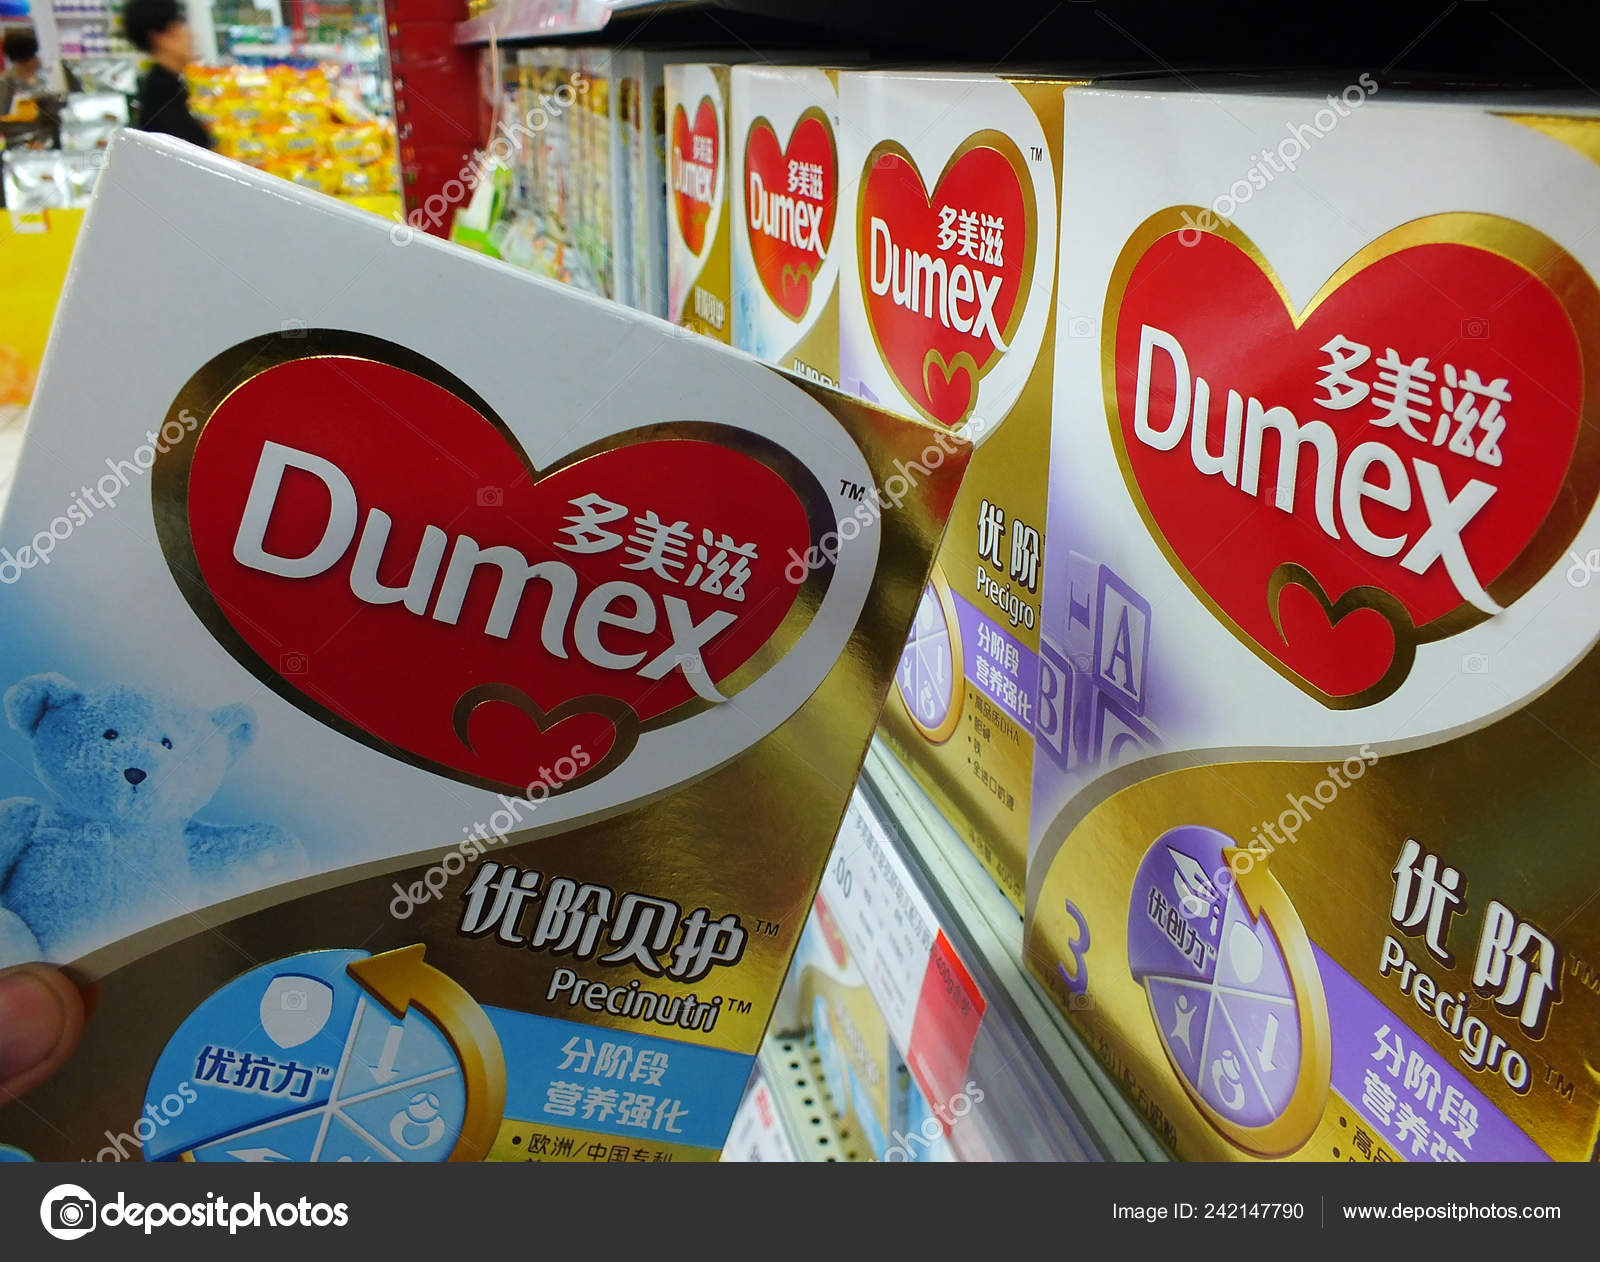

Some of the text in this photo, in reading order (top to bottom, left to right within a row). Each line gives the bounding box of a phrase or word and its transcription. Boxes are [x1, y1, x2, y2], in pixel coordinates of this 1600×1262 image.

[787, 159, 825, 201] 多美滋
[1030, 146, 1043, 162] TM
[749, 170, 828, 261] Dumex
[936, 204, 1005, 268] 多美滋
[870, 215, 1012, 353] Dumex
[1312, 333, 1513, 468] 多美滋
[839, 479, 867, 502] TM
[1133, 323, 1505, 617] Dumex
[232, 439, 739, 704] Dumex
[552, 492, 760, 602] 多美滋
[976, 565, 1034, 630] Precigro
[976, 621, 1020, 678] 分阶段
[460, 861, 747, 979] 优阶贝护
[755, 919, 780, 937] TM
[1057, 899, 1091, 996] 3
[1148, 886, 1206, 970] 优创力
[546, 967, 724, 1033] Precinutri
[727, 997, 753, 1015] TM
[1379, 934, 1532, 1092] Precigro
[194, 1045, 314, 1099] 优抗力
[556, 1035, 670, 1088] 分阶段
[1370, 1023, 1480, 1151] 分阶段
[543, 1079, 690, 1135] 营养强化
